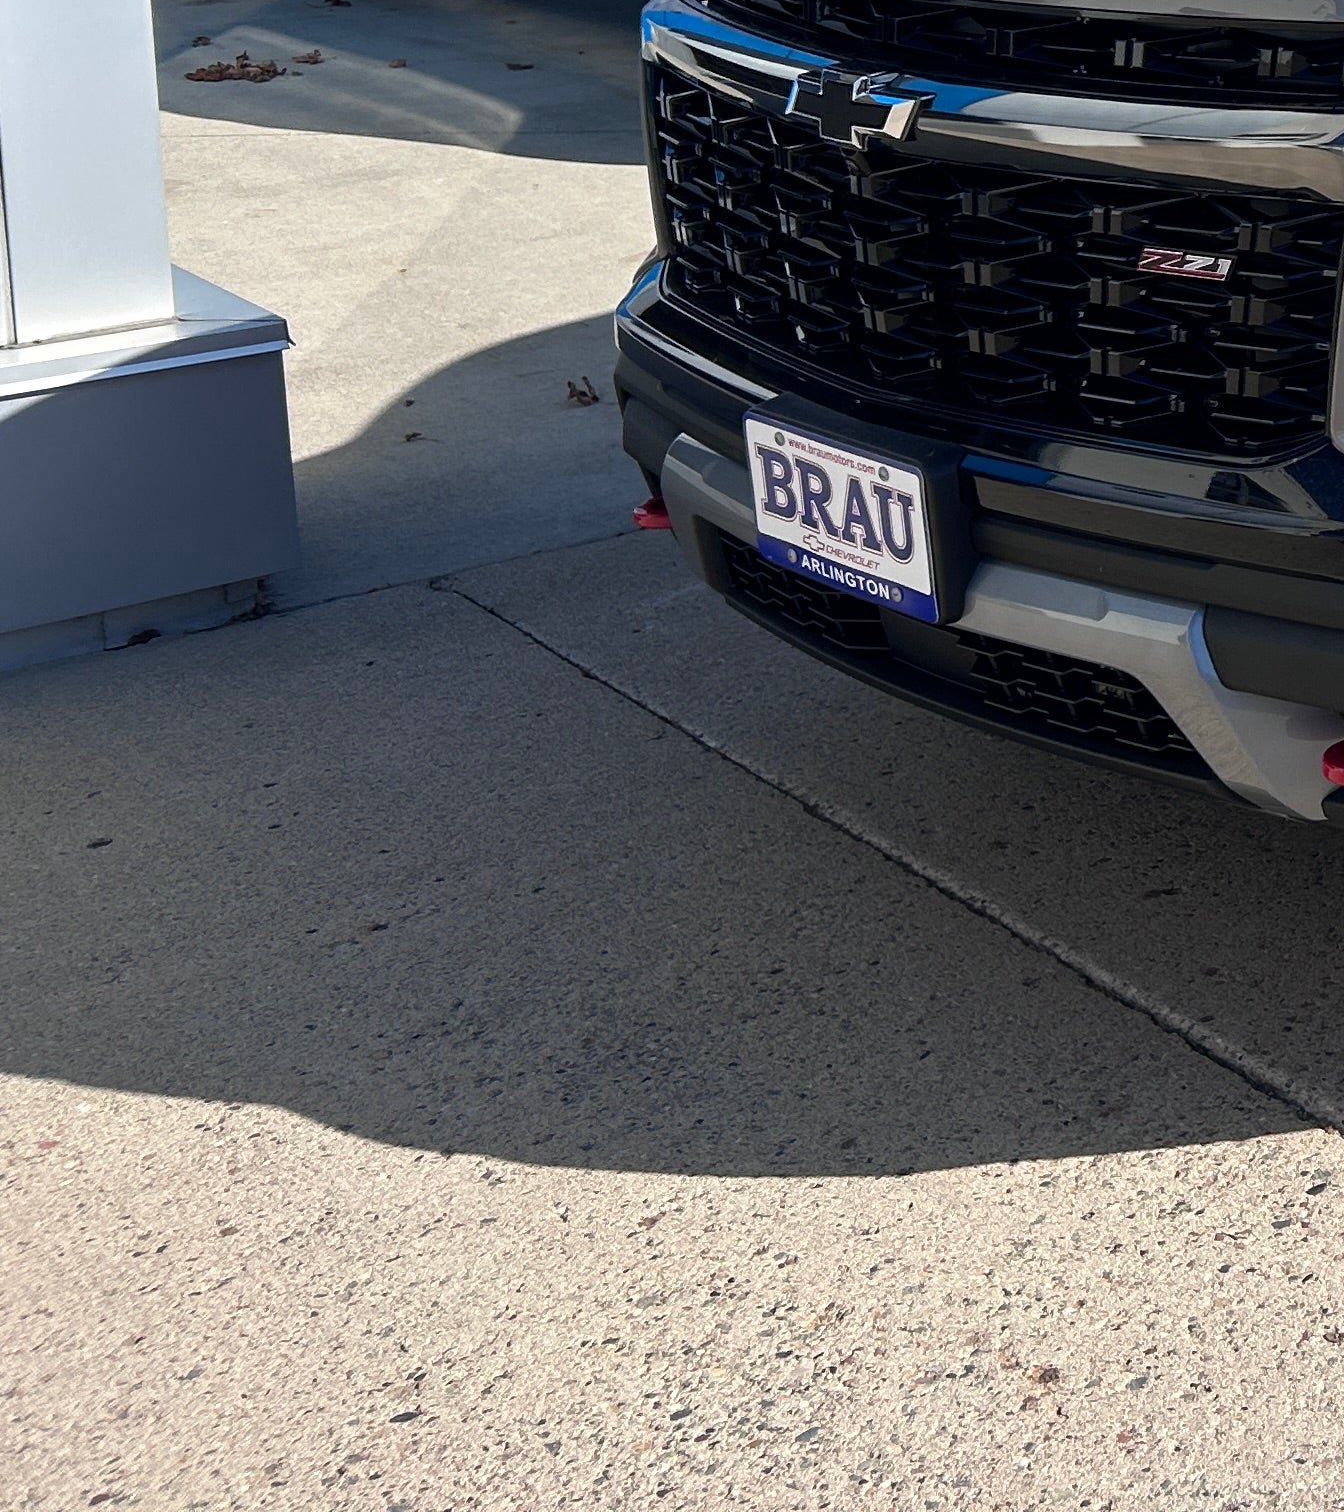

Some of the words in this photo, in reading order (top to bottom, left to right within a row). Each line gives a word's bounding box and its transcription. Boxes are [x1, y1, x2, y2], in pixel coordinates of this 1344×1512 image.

[1136, 247, 1233, 282] Z71
[788, 438, 877, 476] www.braumotors.com
[753, 441, 915, 565] BRAU
[801, 553, 890, 601] ARLINGTON
